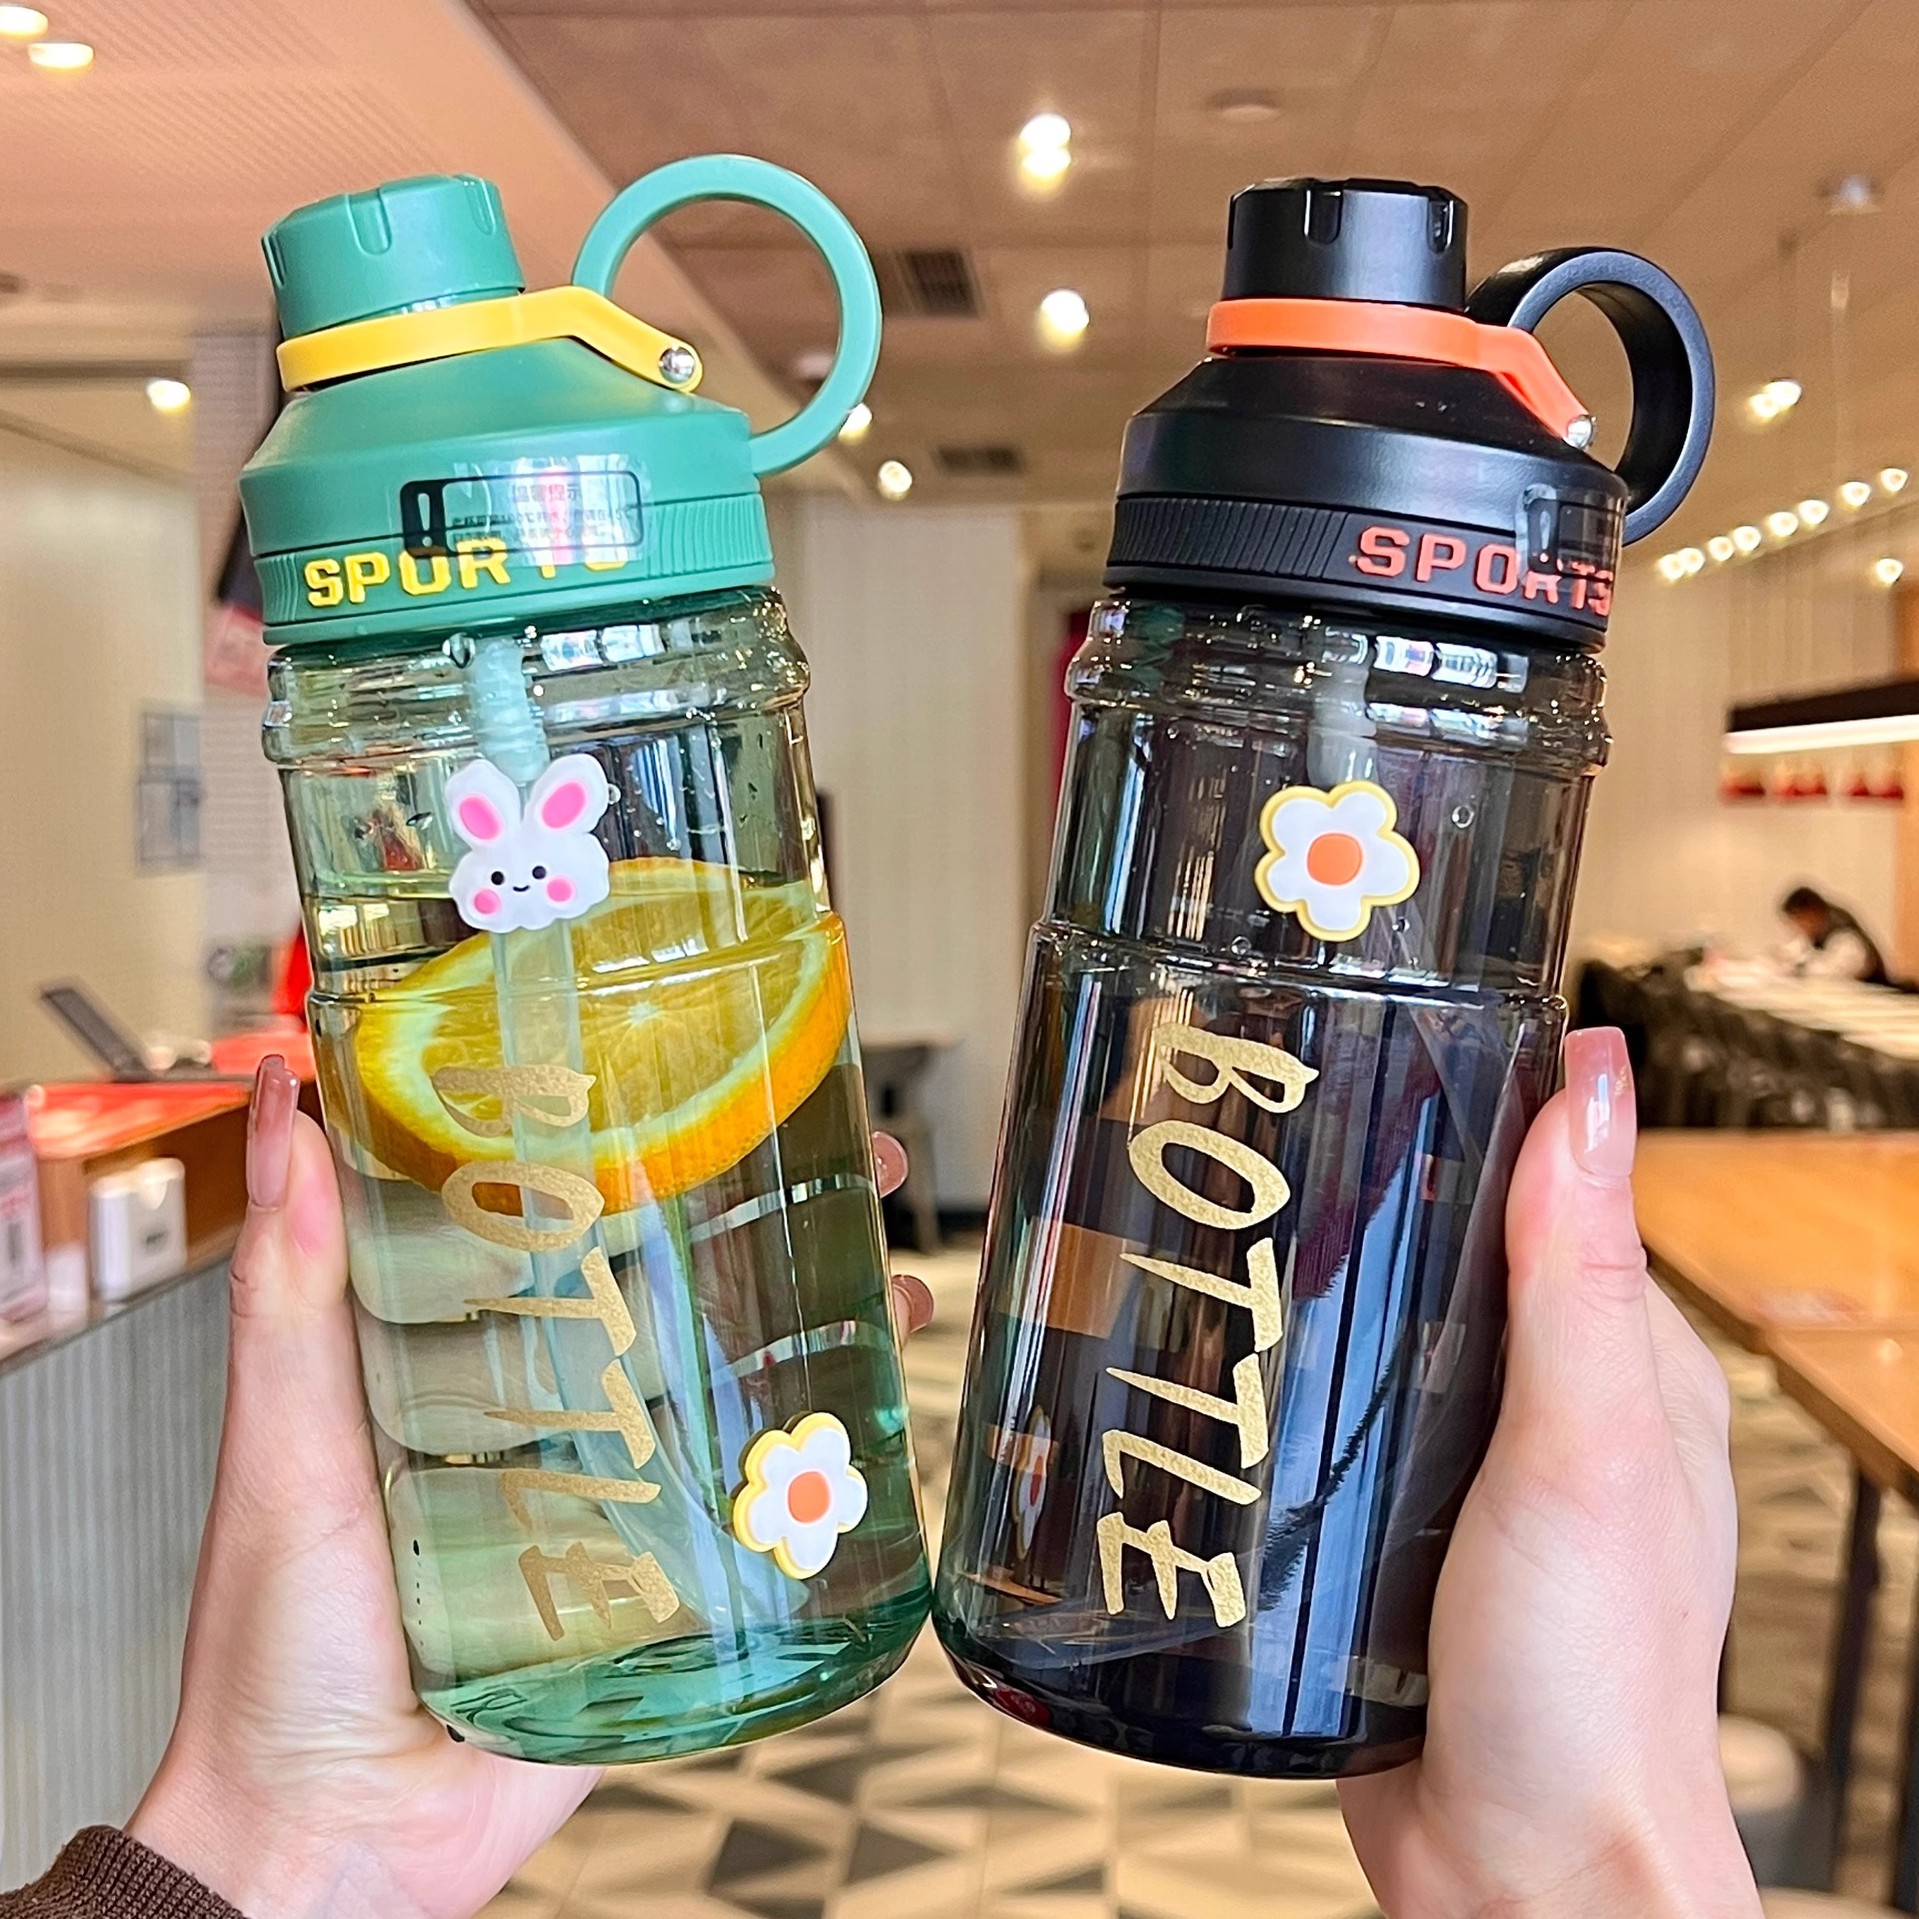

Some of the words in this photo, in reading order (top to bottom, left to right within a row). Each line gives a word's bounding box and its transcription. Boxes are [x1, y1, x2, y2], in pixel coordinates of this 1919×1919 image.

[304, 536, 627, 607] SPOR
[431, 1064, 681, 1642] BOTTLE
[1097, 1021, 1320, 1628] BOTTLE
